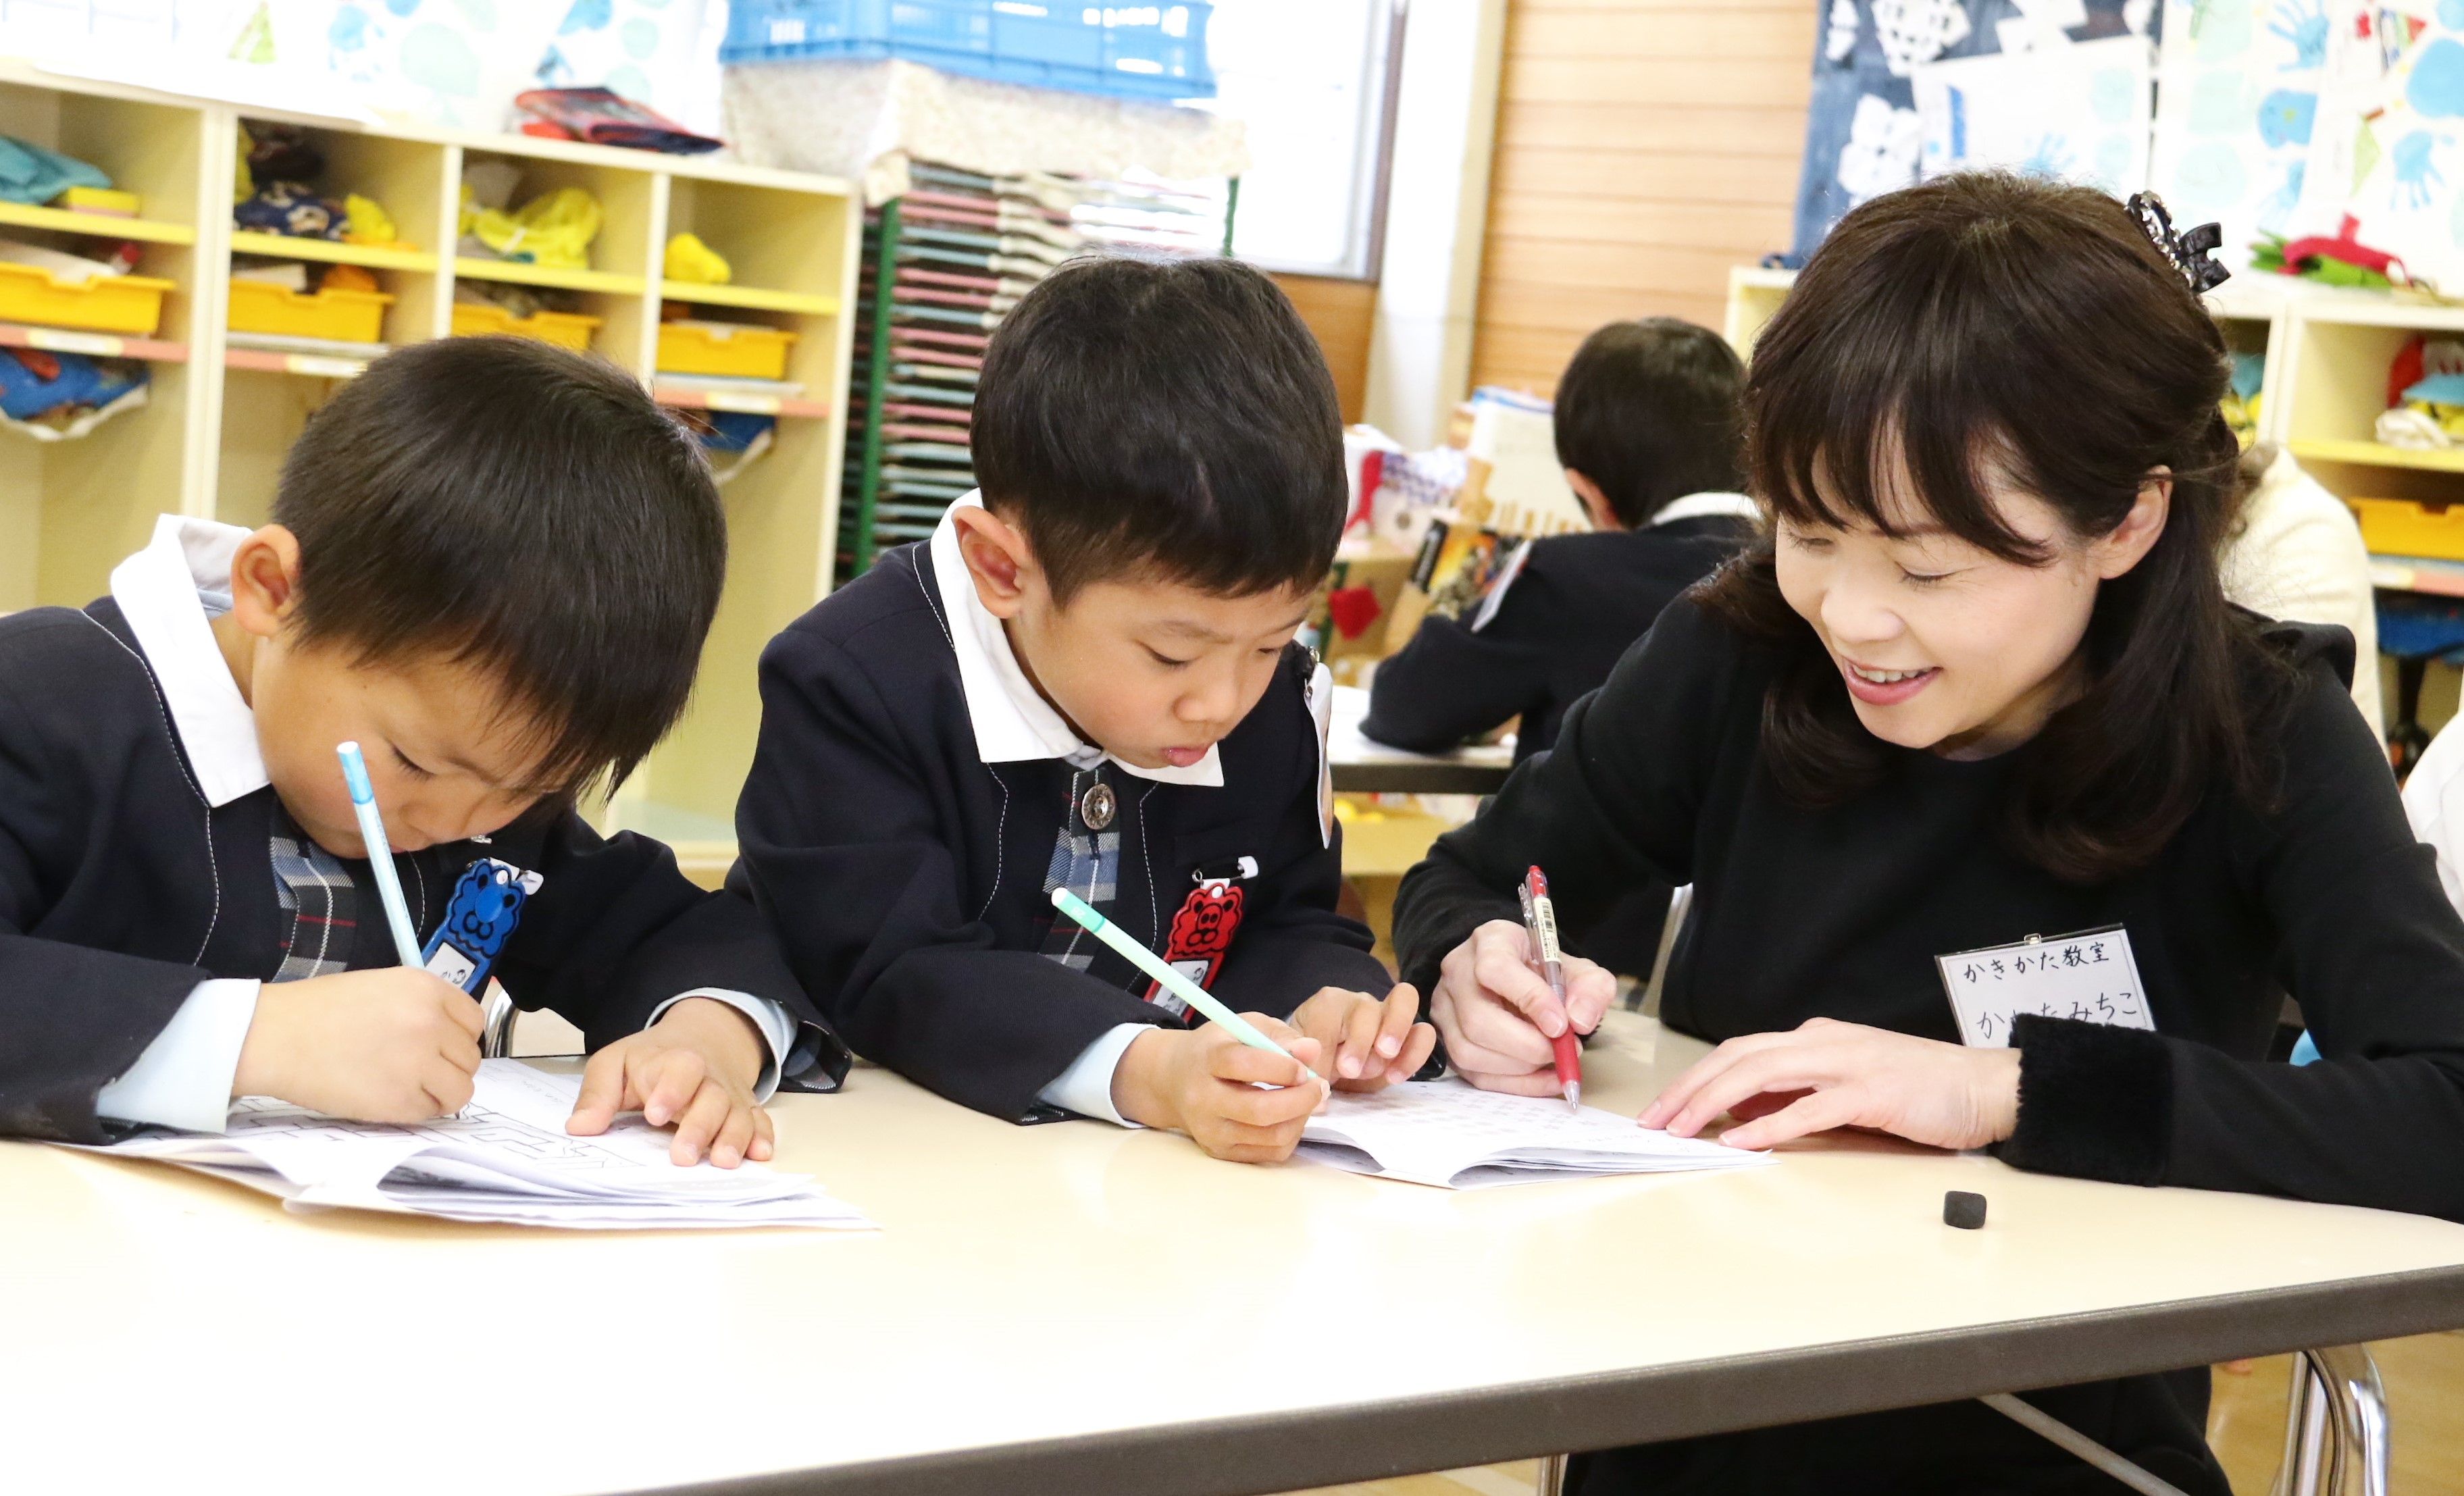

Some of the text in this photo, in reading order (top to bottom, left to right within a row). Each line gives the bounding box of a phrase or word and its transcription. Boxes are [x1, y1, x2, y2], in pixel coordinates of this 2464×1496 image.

[1964, 942, 2110, 983] かきかた教室
